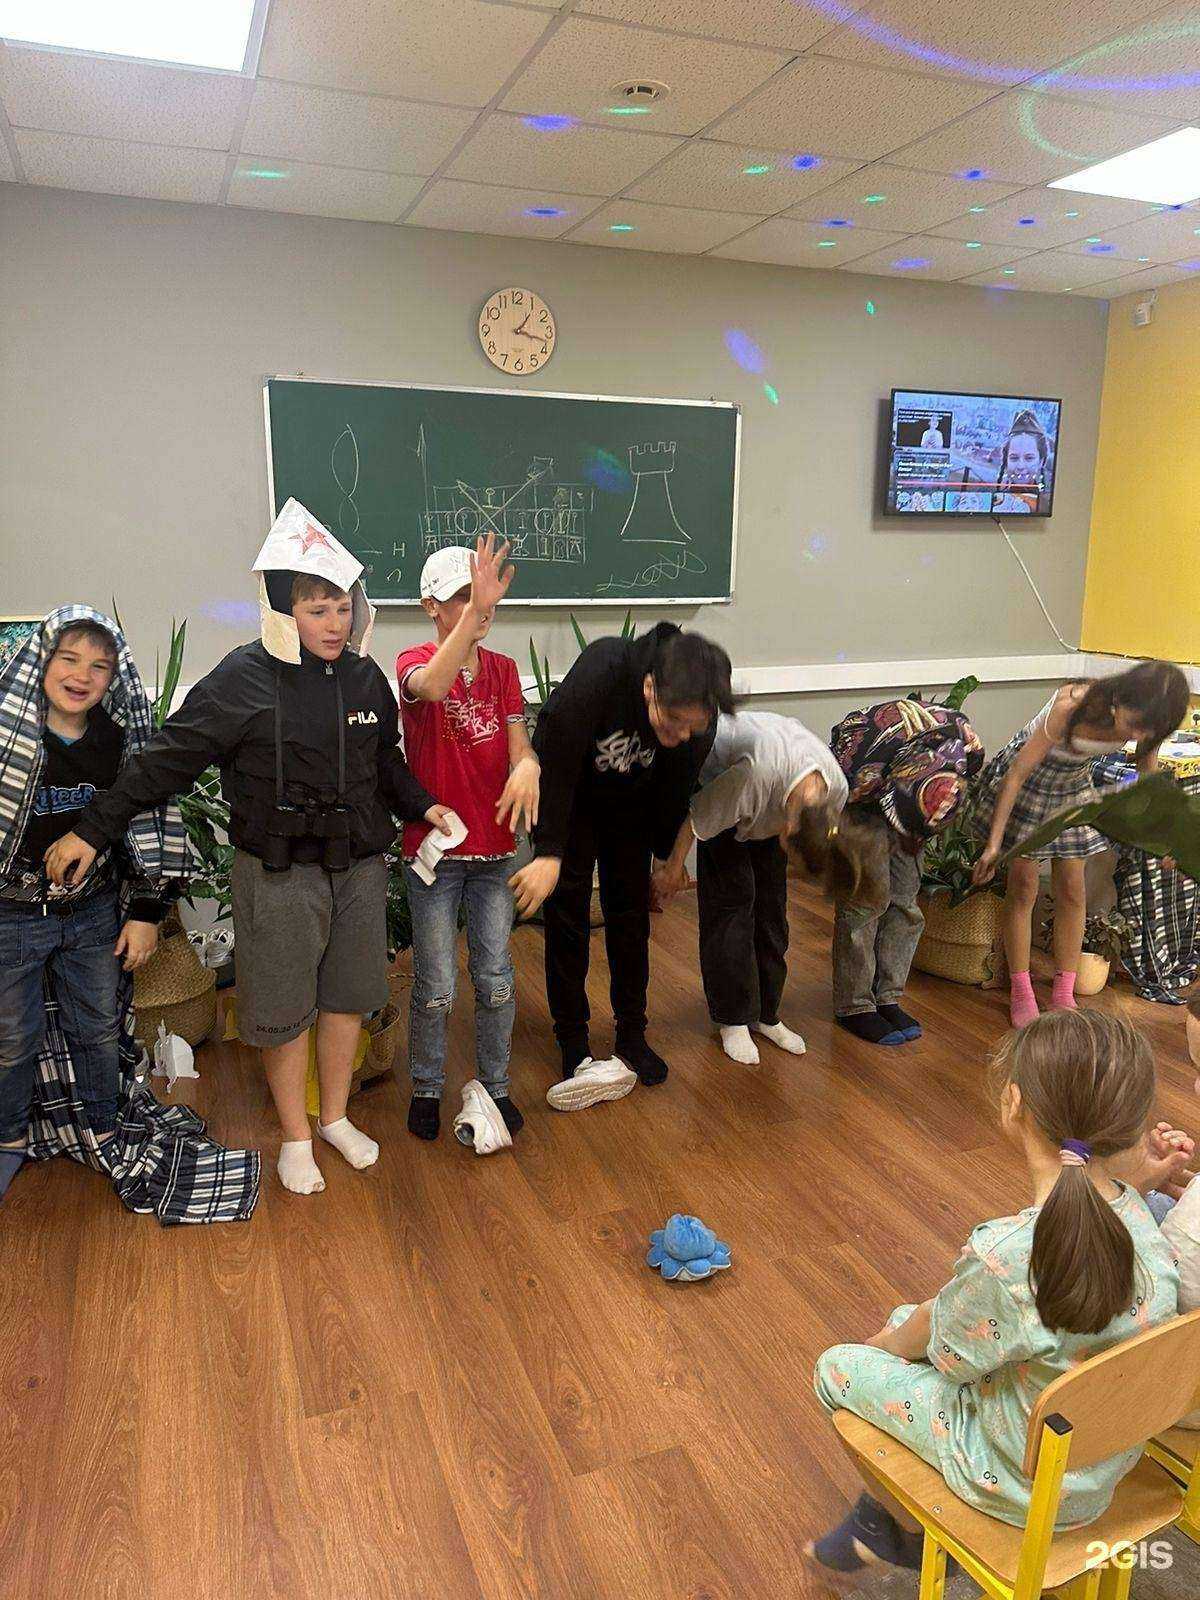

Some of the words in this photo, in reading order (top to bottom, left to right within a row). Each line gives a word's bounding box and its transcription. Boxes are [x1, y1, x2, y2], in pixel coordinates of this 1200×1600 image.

[499, 295, 507, 308] 11
[512, 291, 523, 305] 12
[486, 307, 500, 321] 10
[540, 309, 548, 322] 2
[481, 324, 490, 337] 9
[545, 326, 553, 339] 3
[488, 341, 496, 355] 8
[540, 341, 548, 355] 4
[500, 353, 508, 366] 7
[514, 358, 523, 371] 6
[530, 354, 539, 367] 5
[347, 708, 379, 726] FILA
